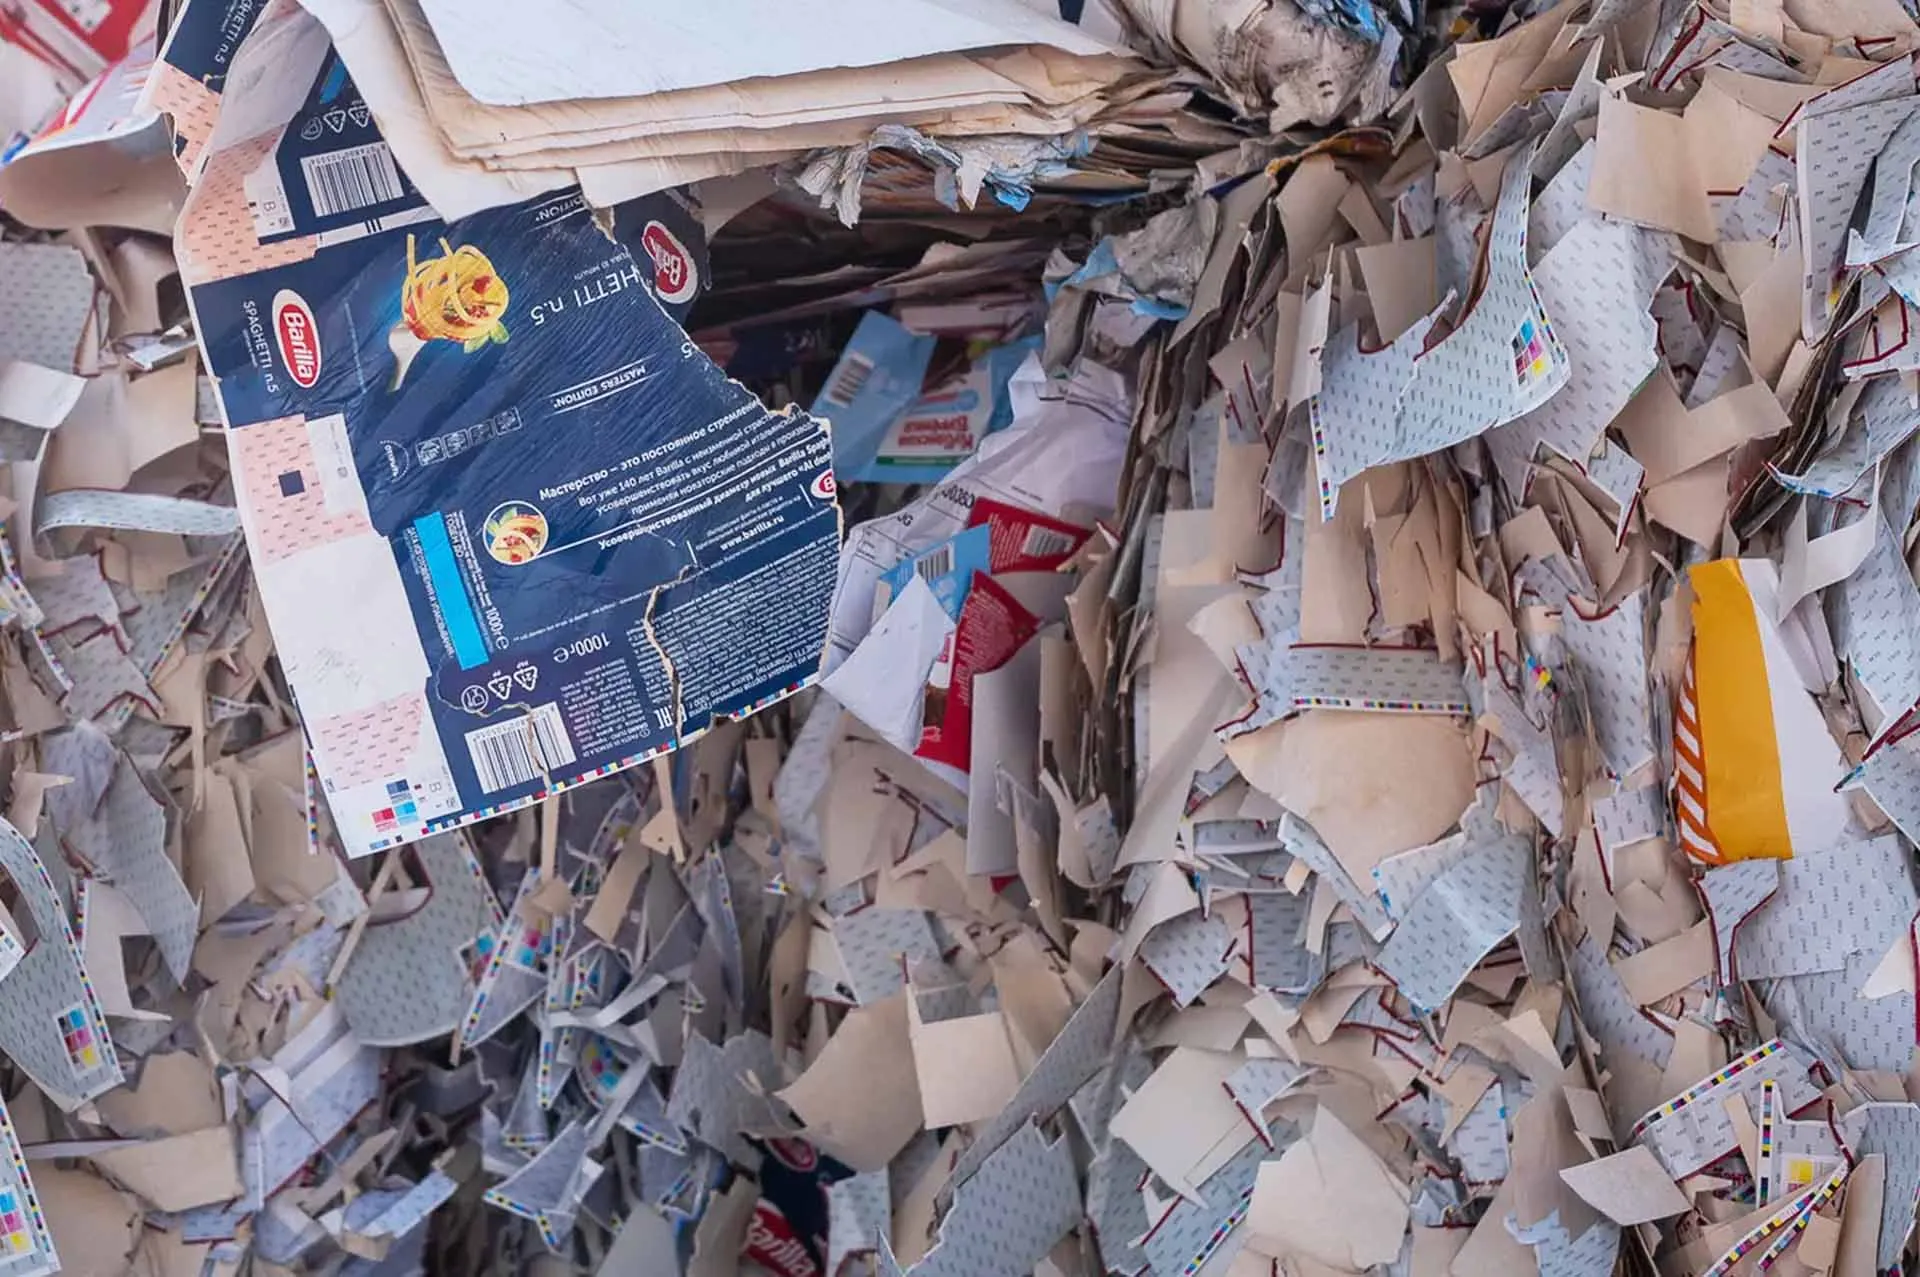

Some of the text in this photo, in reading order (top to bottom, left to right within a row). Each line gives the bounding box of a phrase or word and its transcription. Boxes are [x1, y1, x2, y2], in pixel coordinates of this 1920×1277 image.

[530, 297, 564, 326] n.5
[243, 300, 273, 369] SPAGHETTI
[264, 373, 279, 393] n.5
[283, 311, 316, 379] Barilla
[600, 365, 647, 391] MASTERS
[539, 470, 608, 500] Мастерство
[620, 456, 641, 471] это
[641, 427, 707, 462] постоянное
[778, 450, 806, 468] Barilla
[578, 494, 597, 507] Вот
[599, 487, 618, 502] уже
[618, 477, 637, 492] 140
[638, 471, 655, 484] лет
[655, 458, 685, 477] Barilla
[596, 472, 691, 516] усовершенствовать
[720, 515, 785, 551] www.barilla.ru
